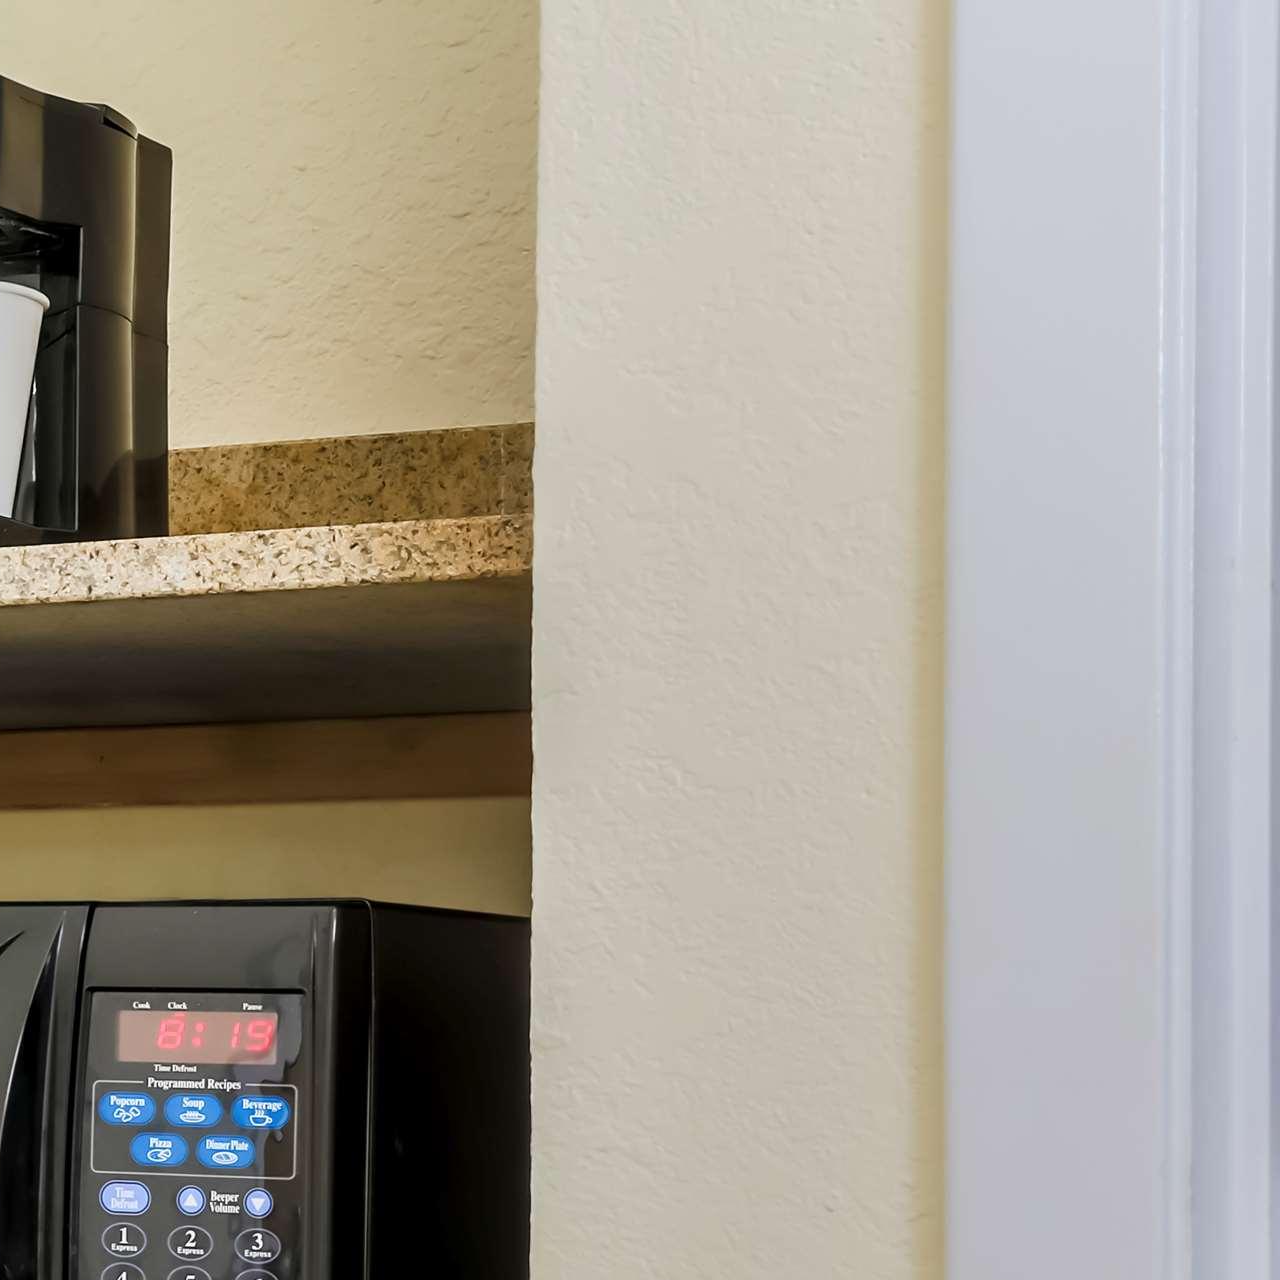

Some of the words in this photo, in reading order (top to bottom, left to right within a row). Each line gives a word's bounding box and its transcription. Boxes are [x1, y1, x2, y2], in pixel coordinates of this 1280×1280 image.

[132, 1001, 151, 1009] Cook
[167, 1001, 188, 1010] Clock
[156, 1019, 274, 1052] 8:19
[153, 1064, 171, 1073] Time
[172, 1065, 197, 1073] Defrost
[147, 1077, 205, 1090] Programmed
[207, 1078, 242, 1091] Recipes
[110, 1096, 146, 1107] Popcorn
[183, 1097, 205, 1109] Soup
[242, 1099, 283, 1111] Beverage
[149, 1137, 172, 1149] Pizza
[205, 1139, 230, 1150] Dinner
[230, 1140, 249, 1151] Plate
[210, 1191, 240, 1203] Beeper
[209, 1202, 240, 1214] Volume
[119, 1227, 129, 1244] 1
[184, 1230, 197, 1247] 2
[251, 1233, 264, 1250] 3
[110, 1243, 138, 1252] Express
[176, 1247, 205, 1256] Express
[243, 1250, 272, 1259] Express
